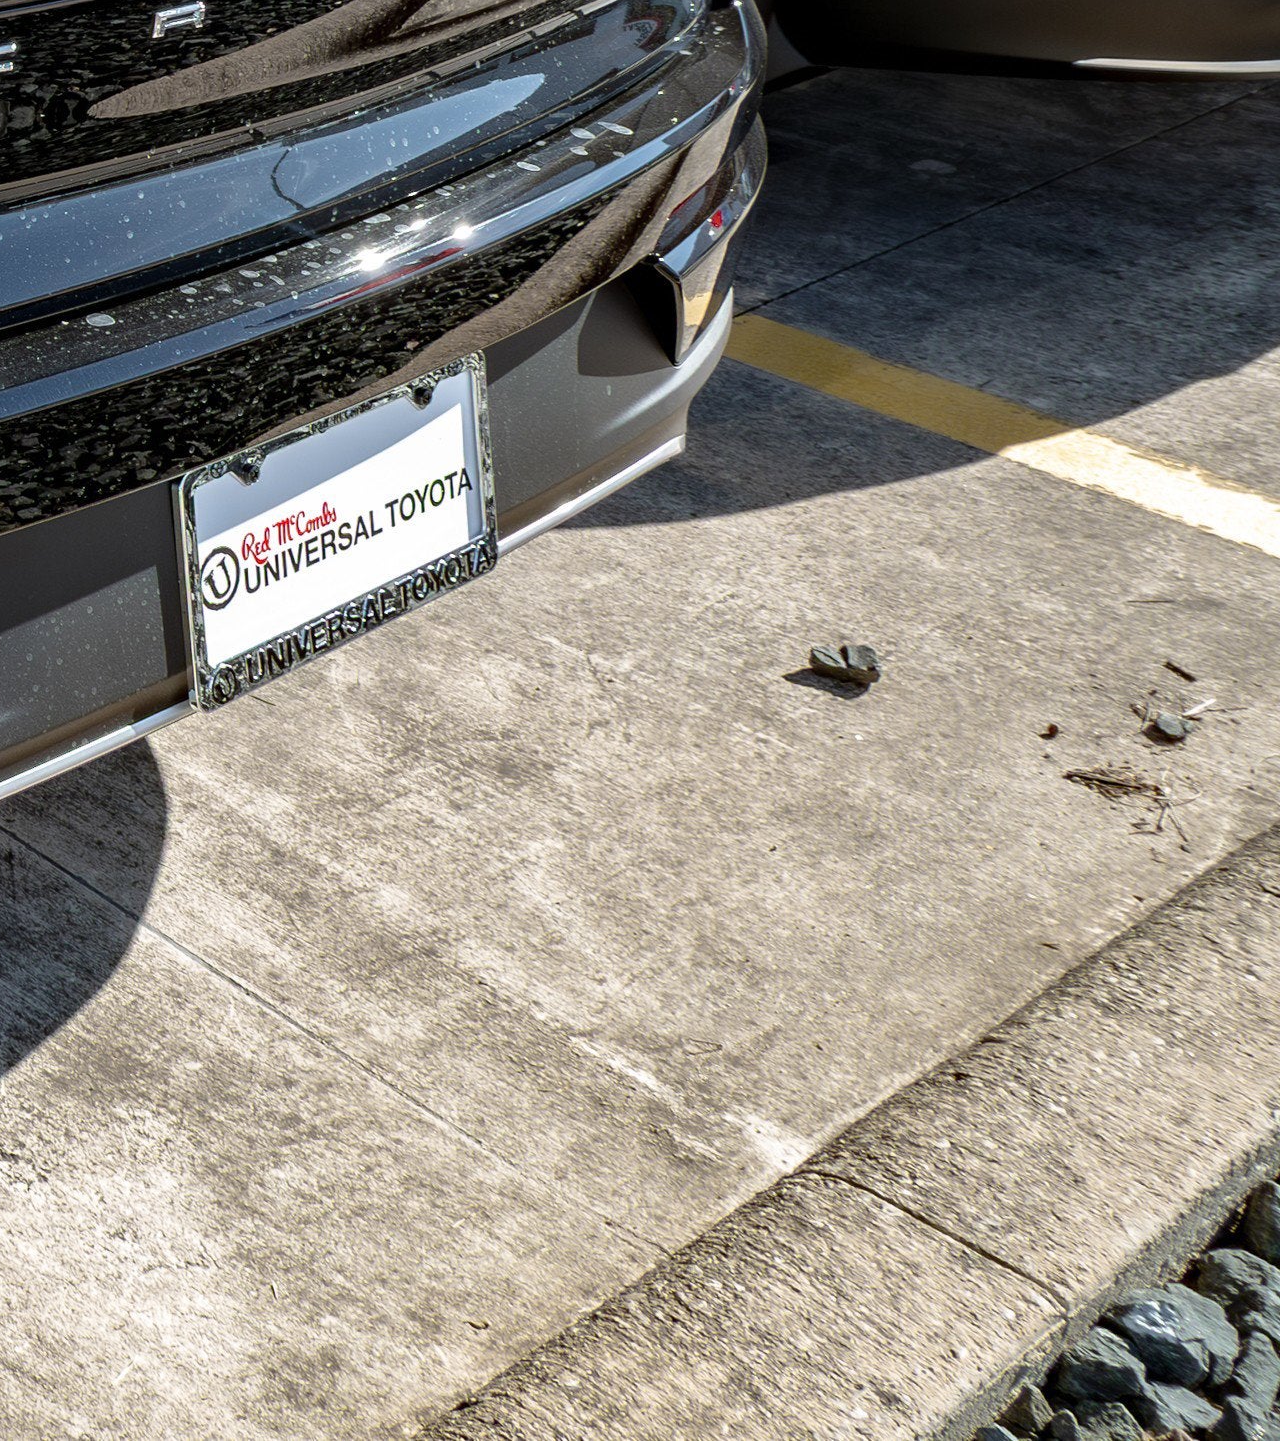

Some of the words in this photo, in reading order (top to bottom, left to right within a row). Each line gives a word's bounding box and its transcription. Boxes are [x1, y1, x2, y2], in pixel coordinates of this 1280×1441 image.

[241, 526, 272, 565] Red
[272, 501, 338, 543] McCombs
[243, 509, 384, 595] UNIVERSAL
[383, 467, 474, 529] TOYOTA
[245, 588, 397, 684] UNIVERSAL
[393, 539, 495, 611] TOYOTA
